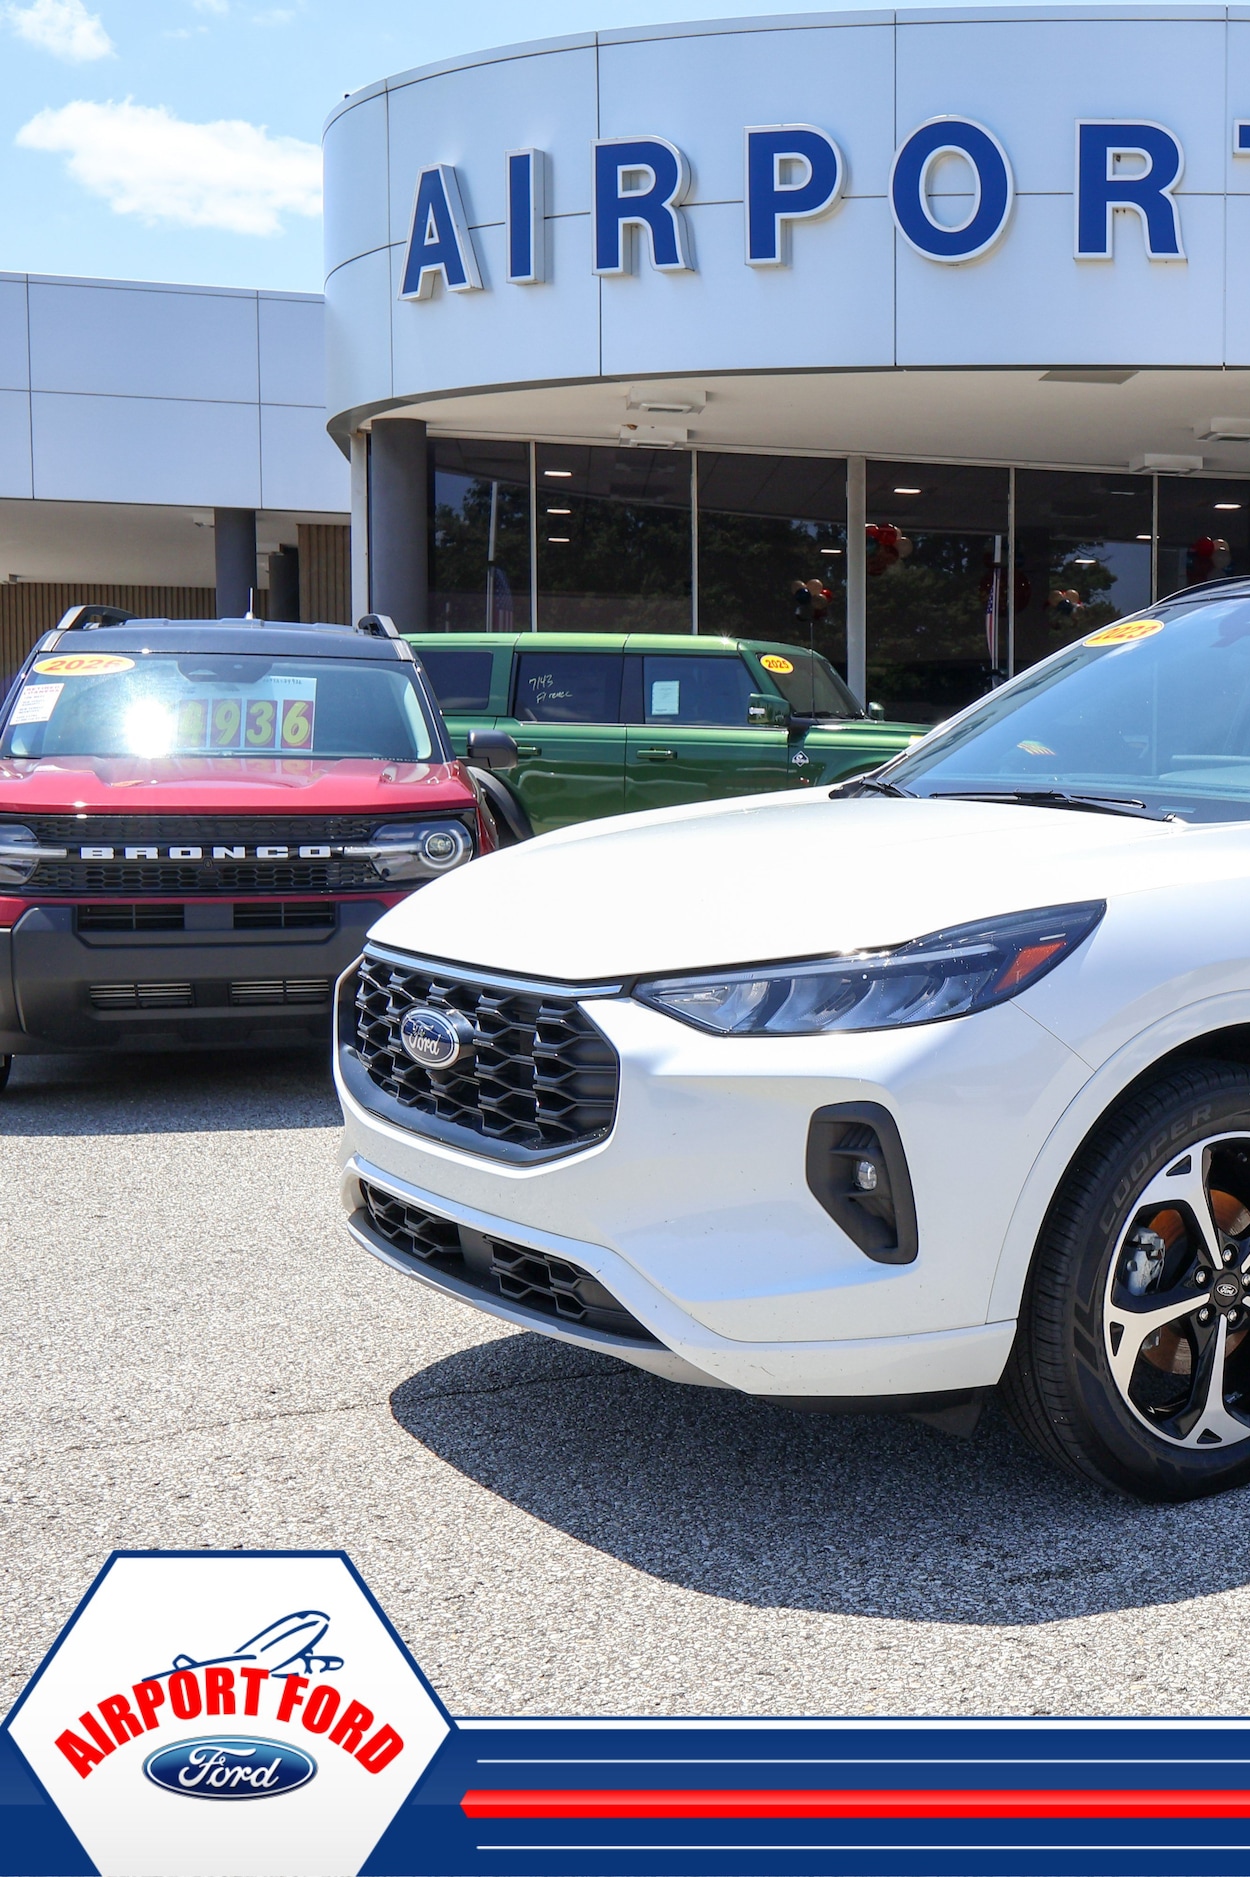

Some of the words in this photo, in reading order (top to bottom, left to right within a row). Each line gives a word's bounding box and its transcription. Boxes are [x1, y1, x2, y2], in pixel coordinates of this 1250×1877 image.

[765, 660, 789, 669] 2025
[529, 674, 554, 691] 7143
[80, 846, 332, 860] BRONCO
[408, 1019, 440, 1056] Ford
[1099, 1104, 1212, 1235] COOPER
